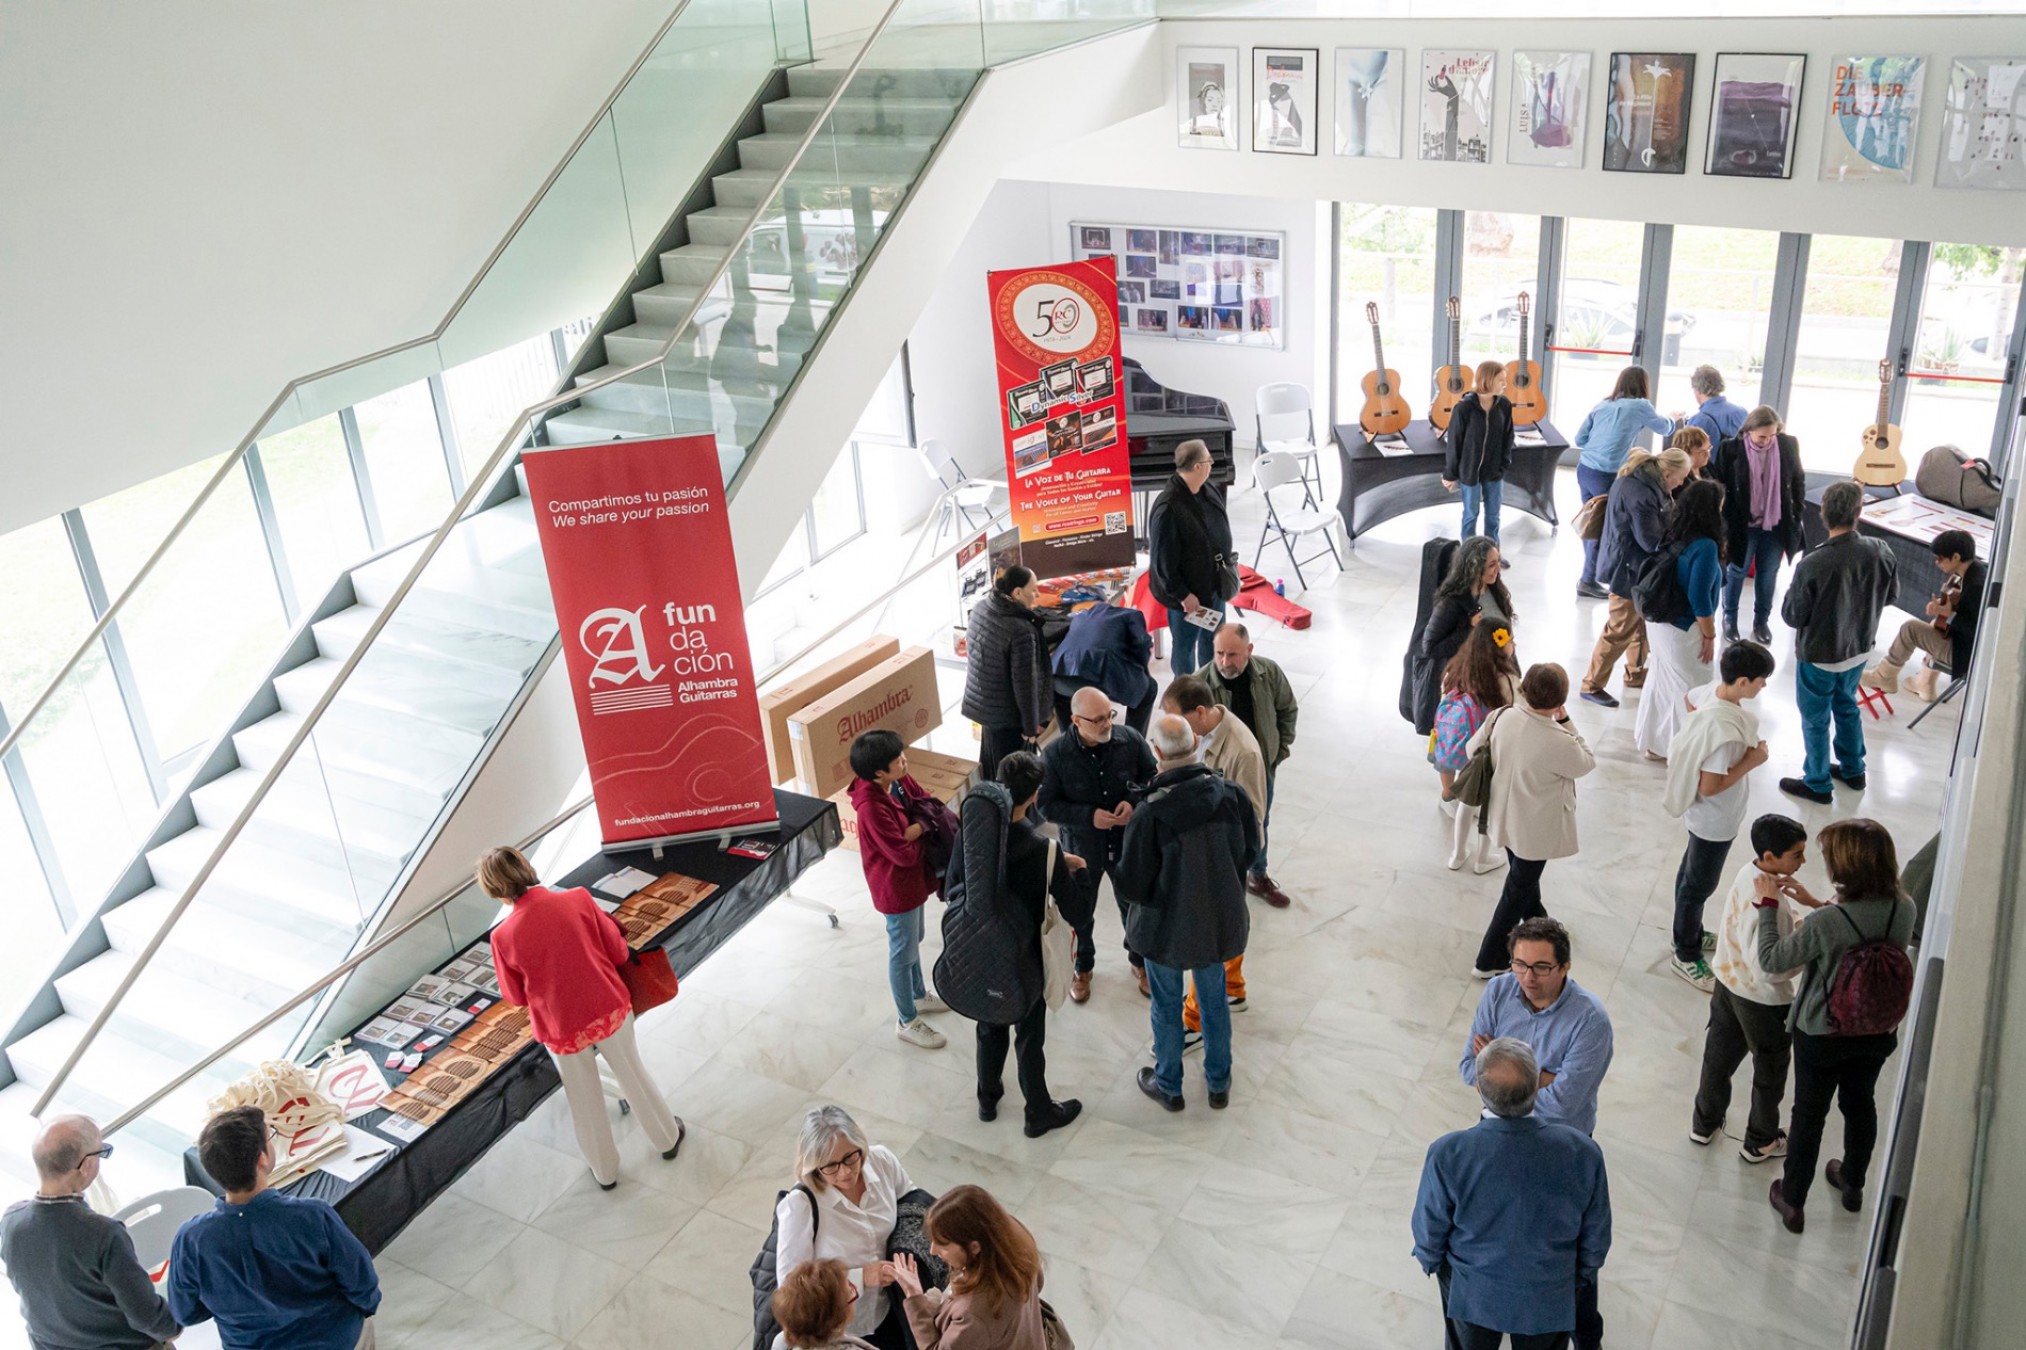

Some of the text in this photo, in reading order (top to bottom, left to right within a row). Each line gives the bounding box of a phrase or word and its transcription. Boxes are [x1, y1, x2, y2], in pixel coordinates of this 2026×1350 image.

[548, 486, 709, 513] Compartimos tu pasión
[552, 502, 709, 528] We share your passion
[662, 601, 717, 626] fun
[669, 626, 708, 651] da
[674, 648, 734, 675] ción
[677, 677, 738, 693] Alhambra
[679, 688, 738, 704] Guitarras
[837, 687, 914, 746] Alhambra
[614, 800, 761, 827] fundacionalhambraguitarras.org
